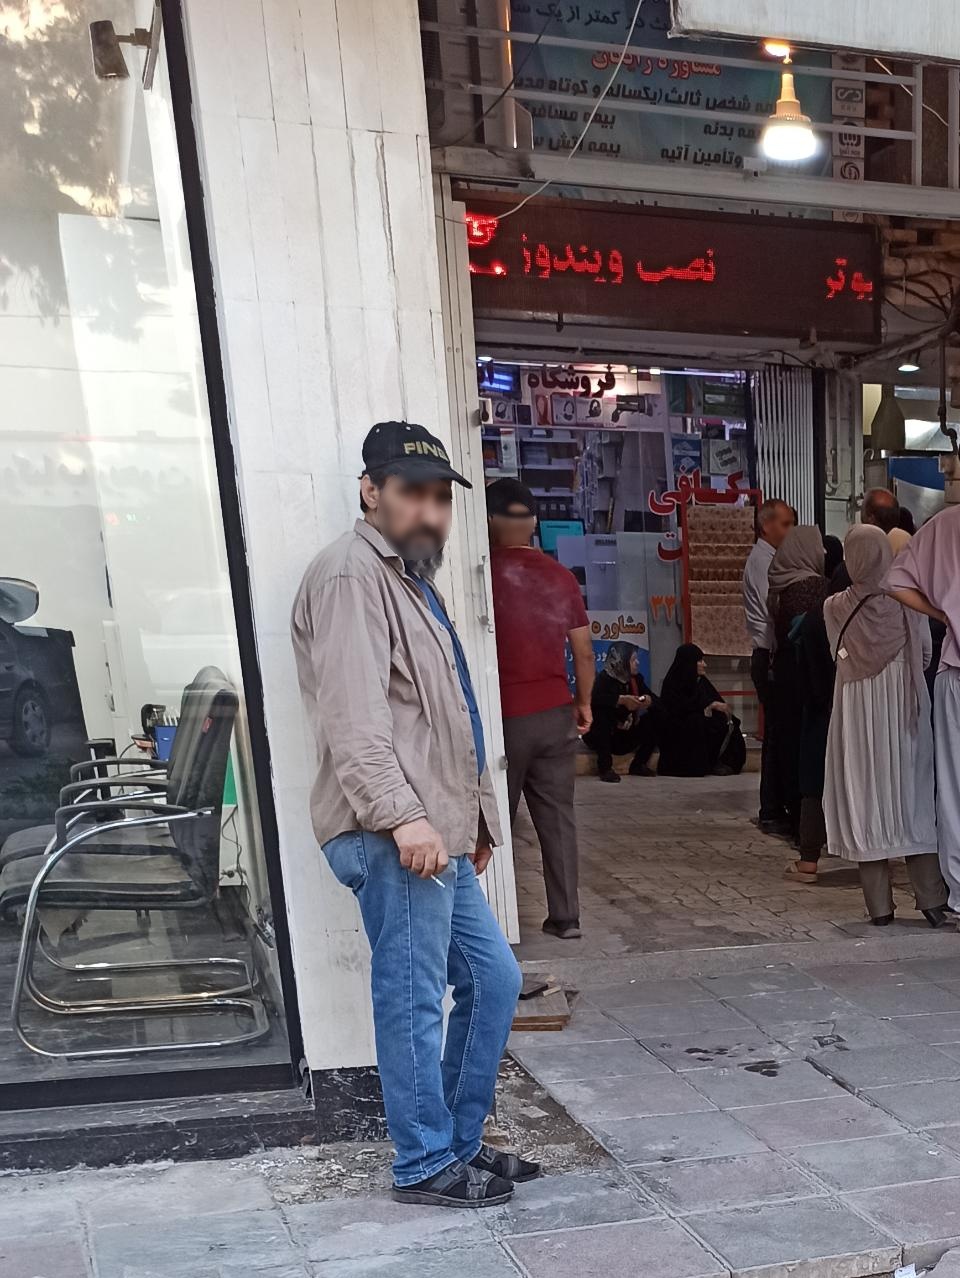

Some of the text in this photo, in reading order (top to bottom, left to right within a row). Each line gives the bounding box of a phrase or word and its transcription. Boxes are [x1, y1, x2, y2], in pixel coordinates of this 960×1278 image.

[566, 5, 580, 23] از
[585, 10, 621, 26] کمتر
[548, 77, 589, 96] کوتاه
[583, 111, 616, 130] بیمه
[703, 121, 735, 141] بدنه
[588, 140, 621, 158] بیمه
[660, 144, 691, 163] آتیه
[520, 232, 624, 285] ویندوز
[635, 248, 716, 284] نصب
[527, 362, 616, 398] فروشگاه
[648, 463, 746, 516] کافی
[591, 614, 647, 640] مشاوره
